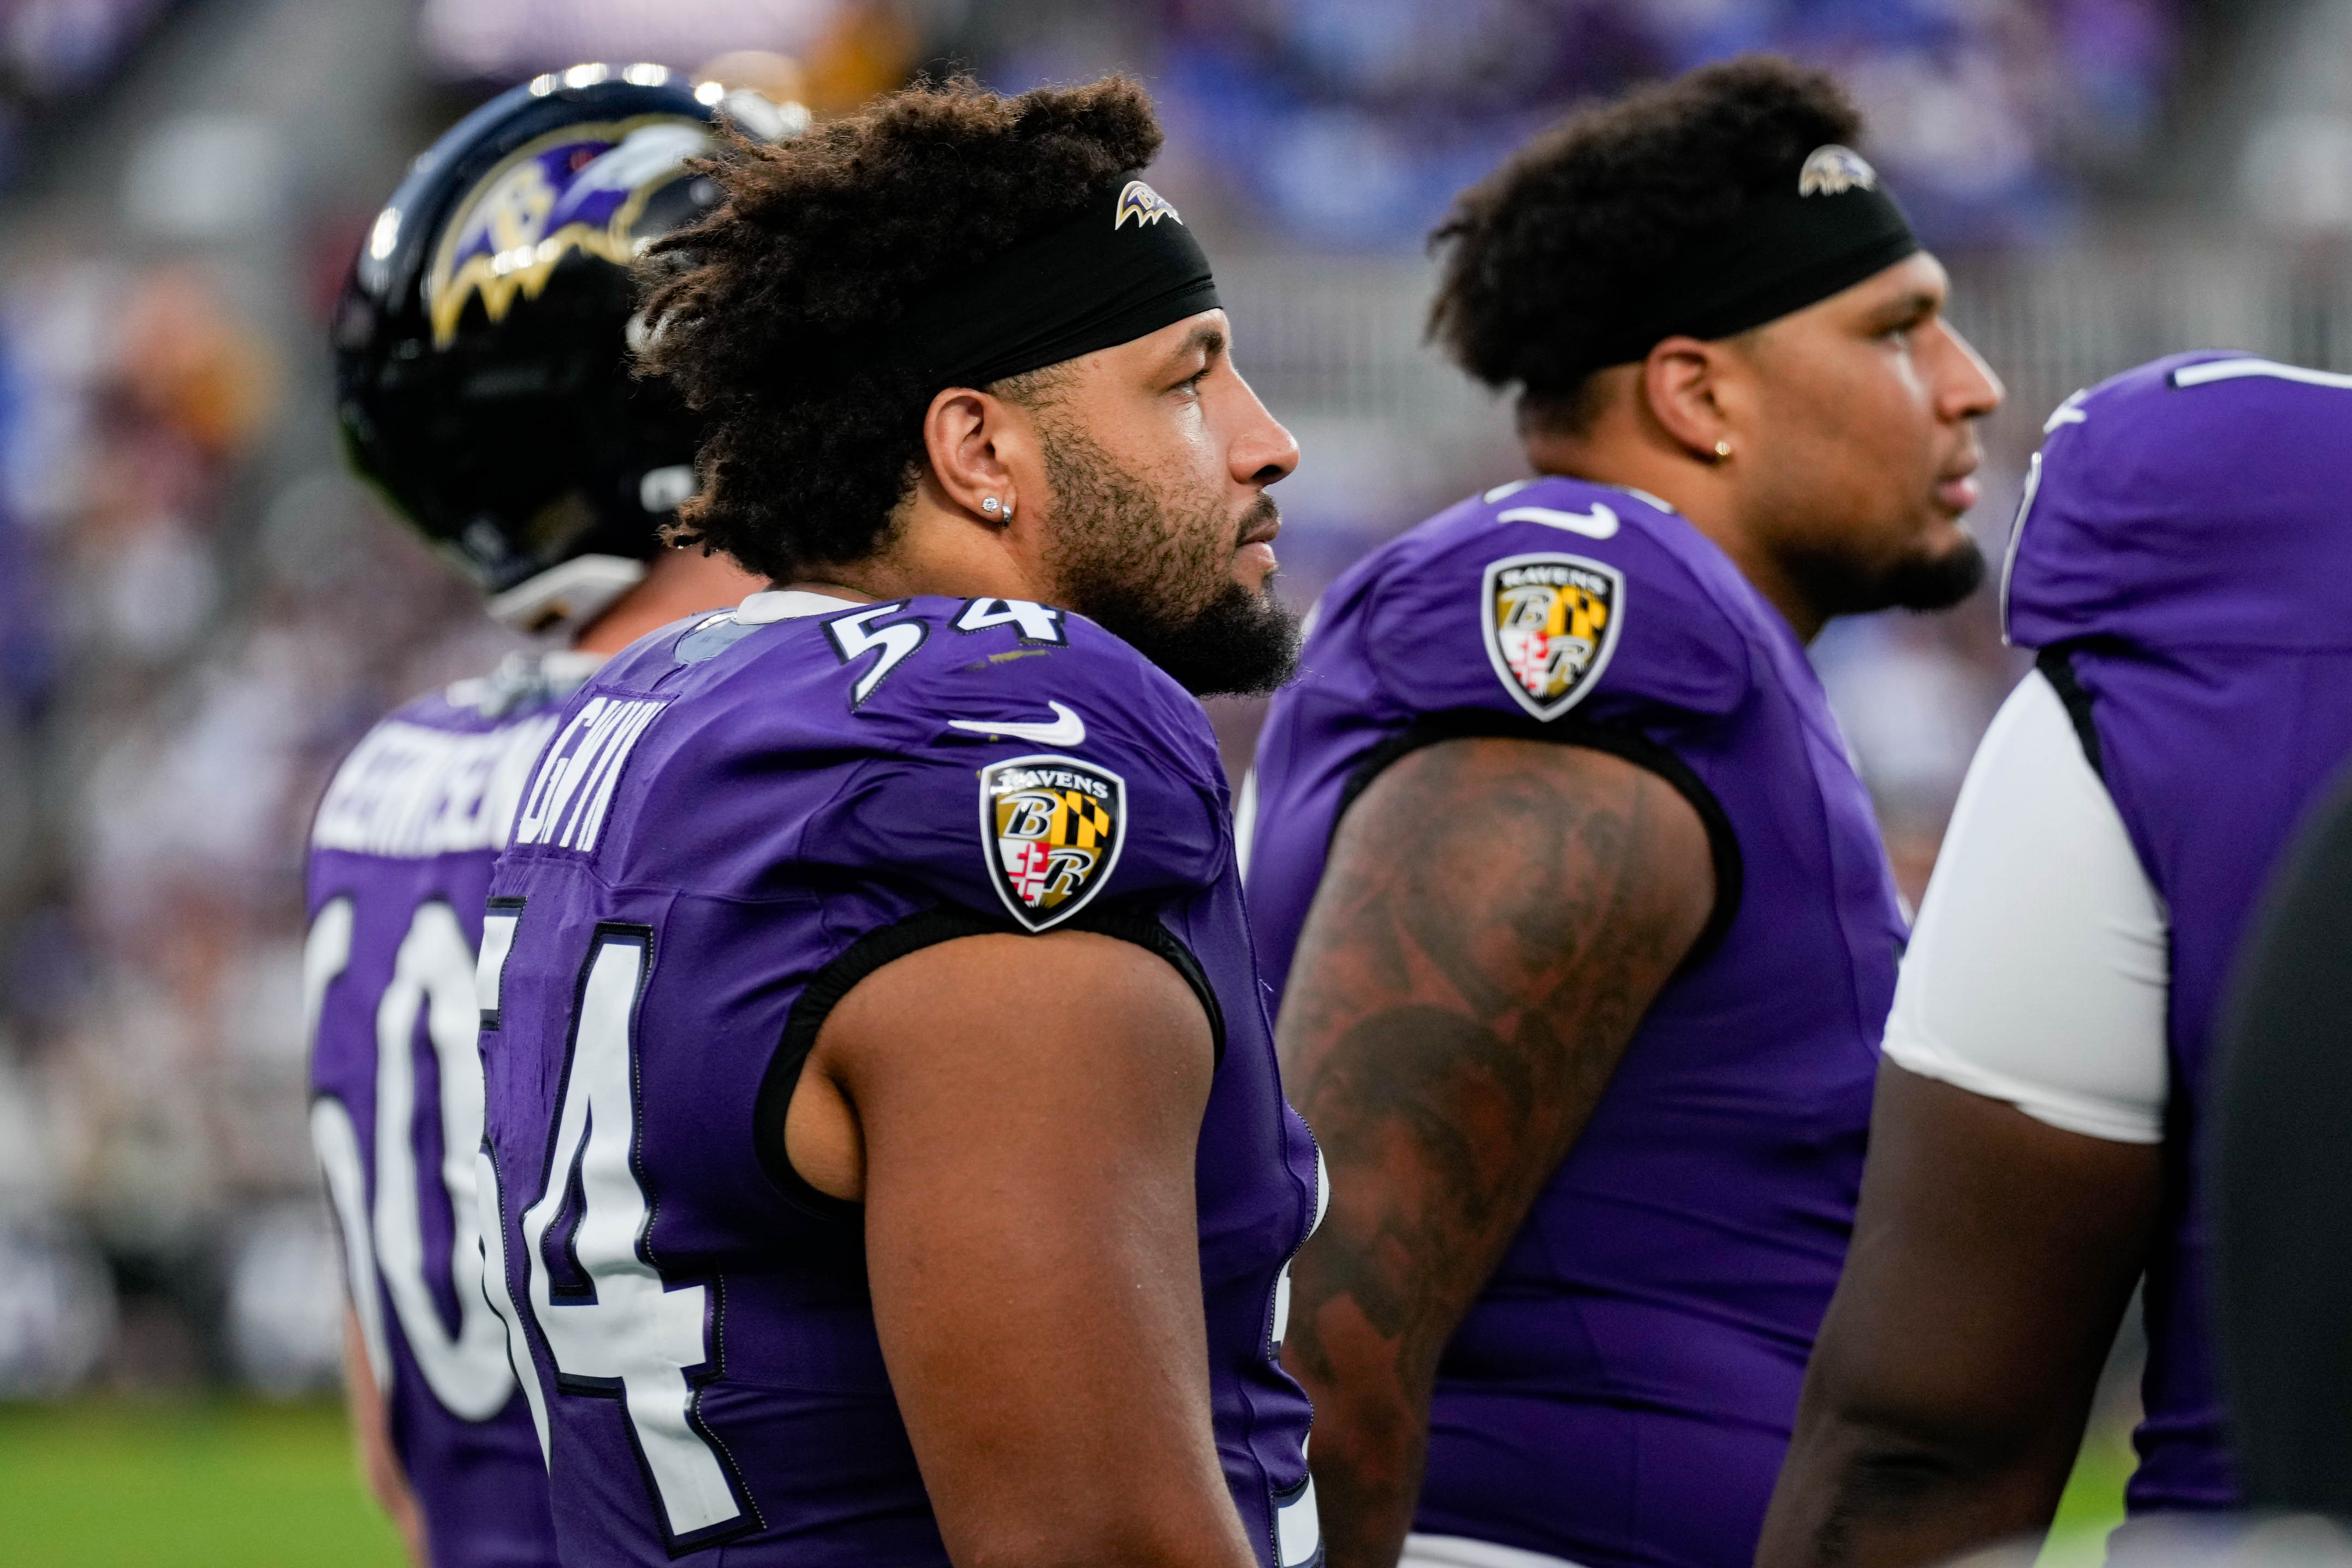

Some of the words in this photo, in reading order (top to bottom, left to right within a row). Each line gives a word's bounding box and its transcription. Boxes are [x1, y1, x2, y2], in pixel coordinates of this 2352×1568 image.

[1499, 566, 1608, 596] RAVENS
[819, 597, 1069, 714] 54
[998, 768, 1108, 799] RAVENS
[999, 791, 1059, 839] B
[1043, 848, 1094, 895] R
